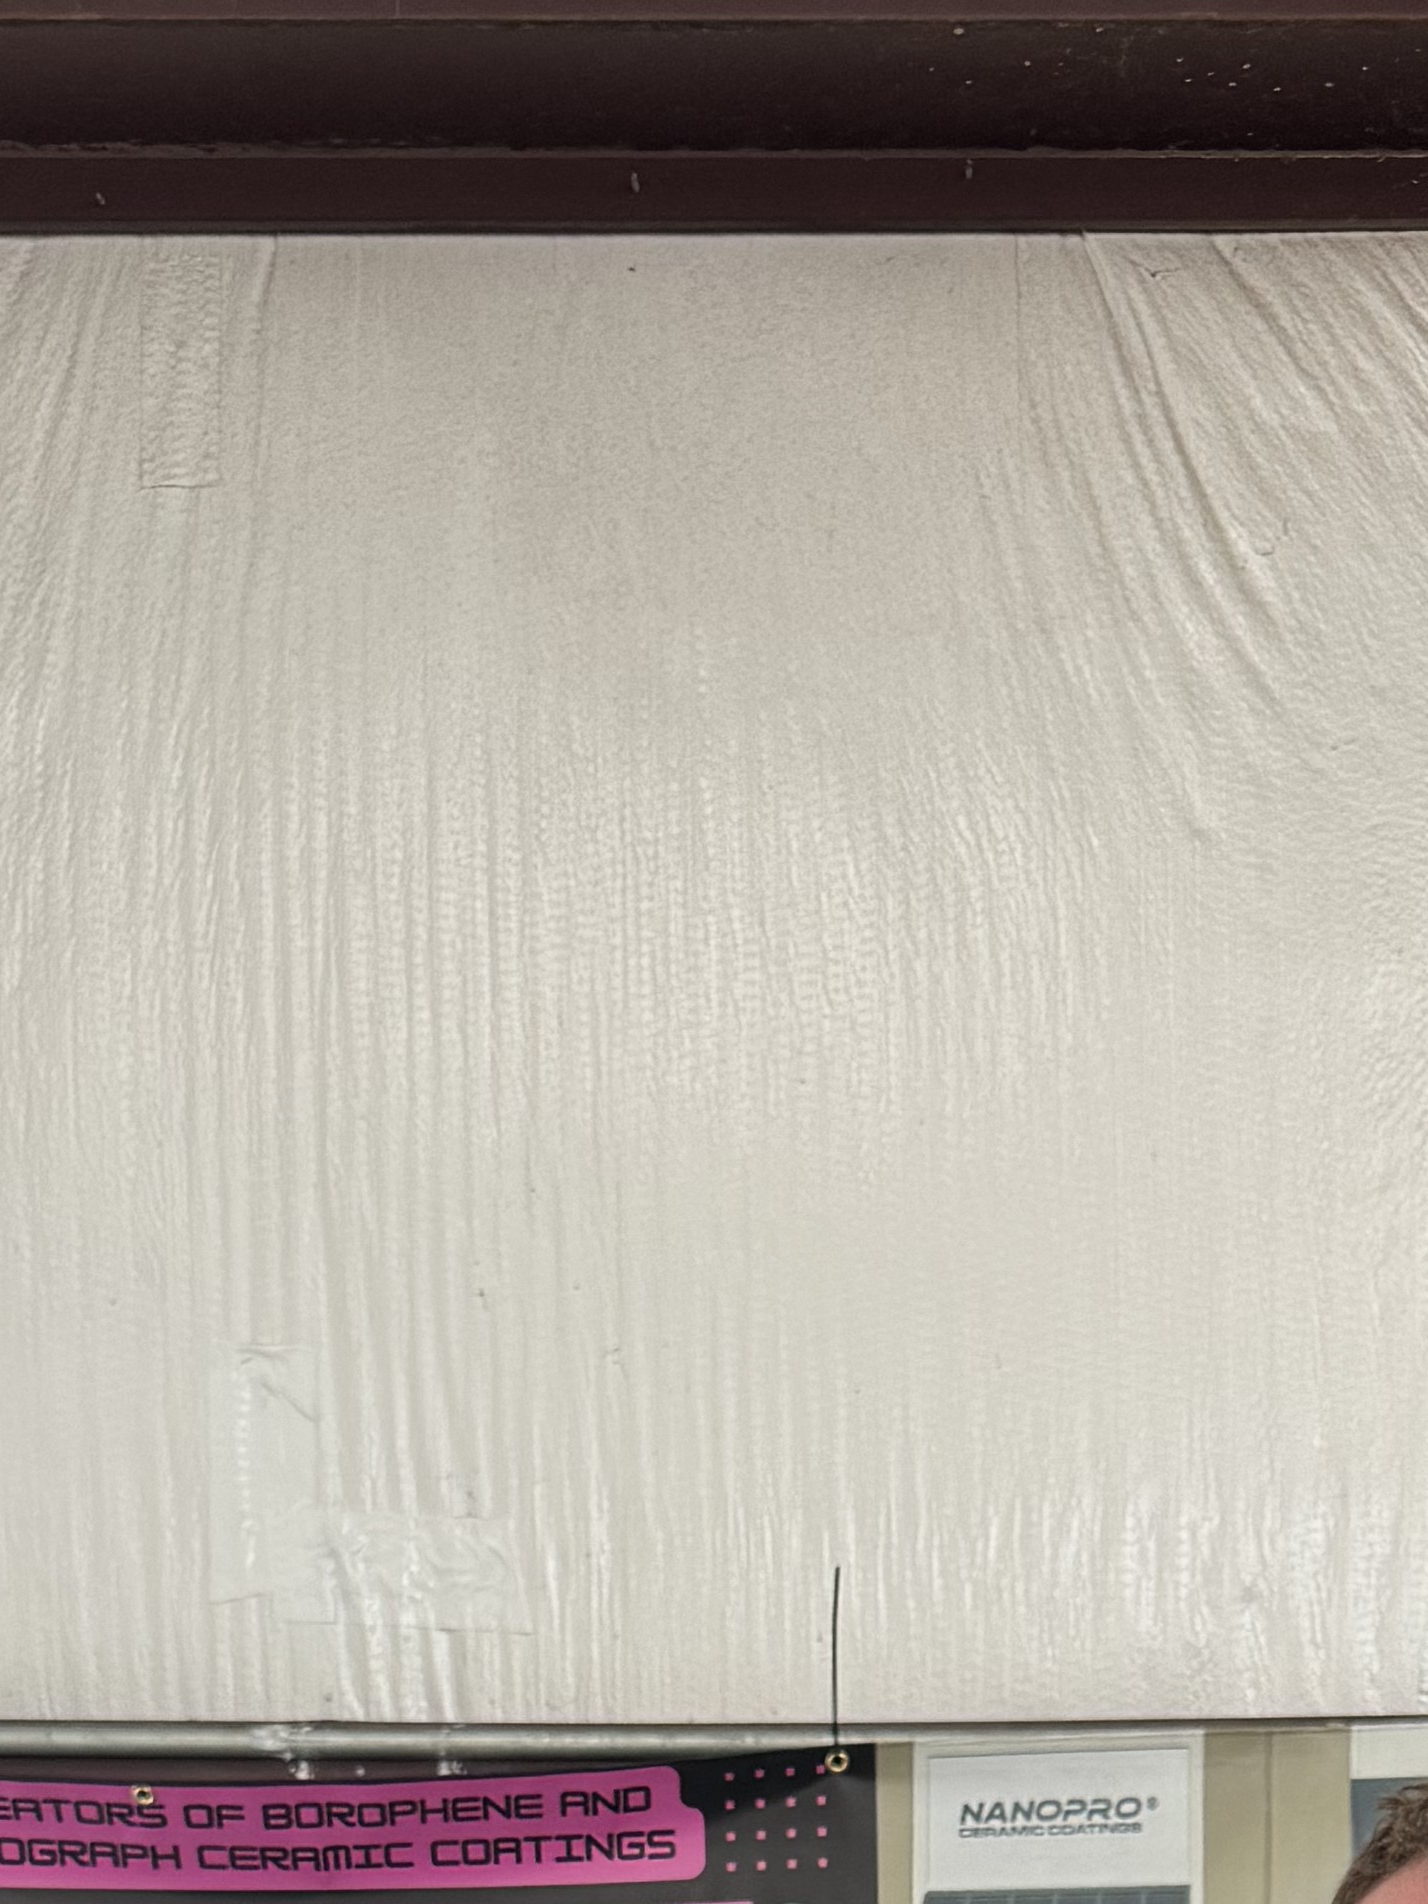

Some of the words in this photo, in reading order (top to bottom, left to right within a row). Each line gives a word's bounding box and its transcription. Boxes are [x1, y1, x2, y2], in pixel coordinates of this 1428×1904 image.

[183, 1803, 245, 1830] OF
[263, 1793, 544, 1830] BOROPHENE
[559, 1786, 652, 1817] AND
[197, 1841, 415, 1871] CERAMIC
[430, 1830, 677, 1868] COATINGS
